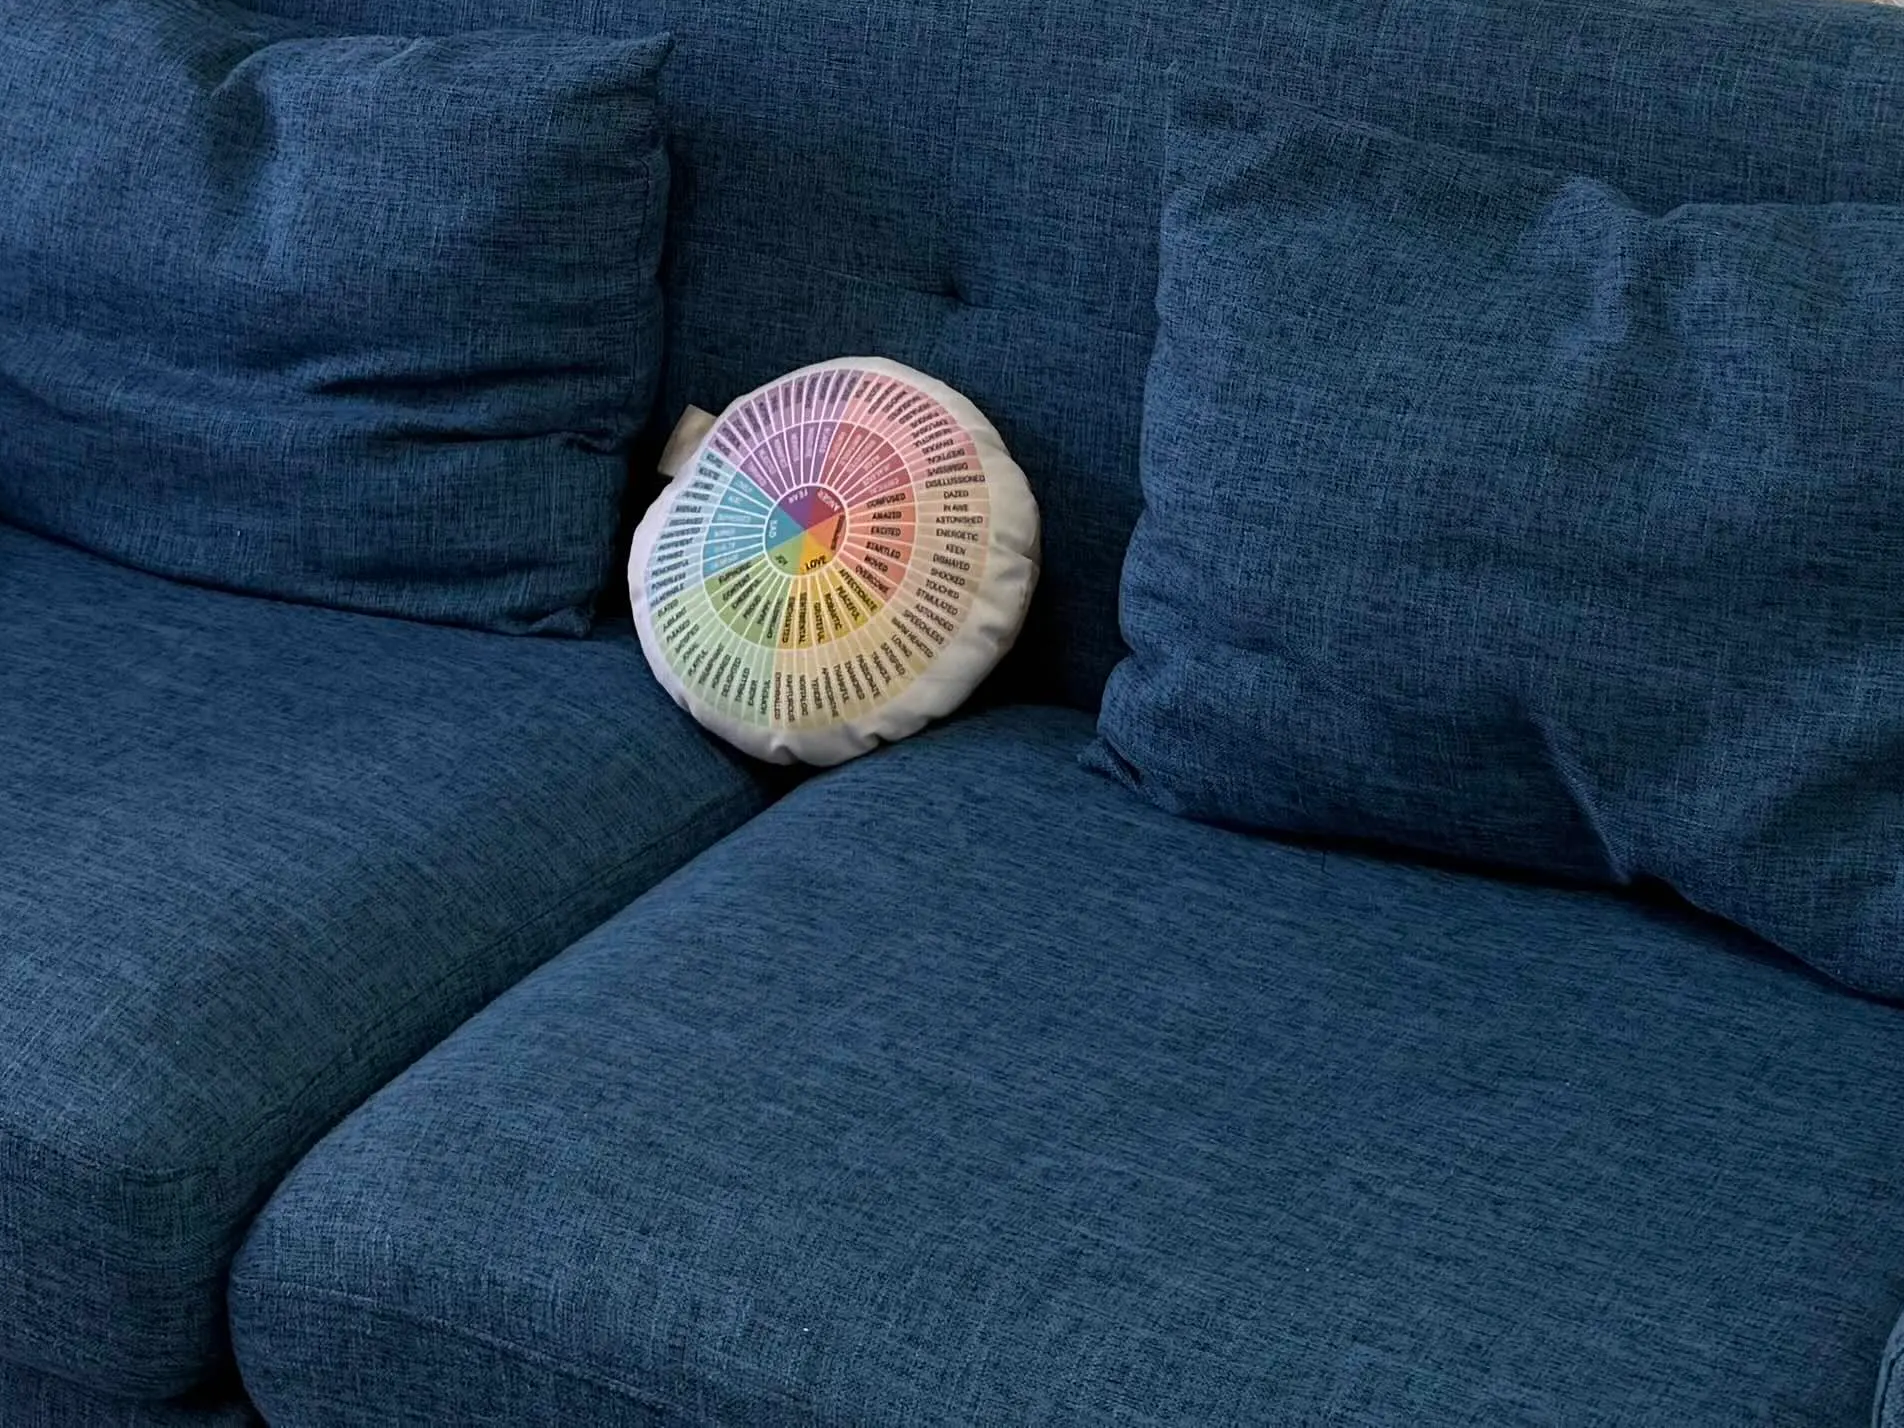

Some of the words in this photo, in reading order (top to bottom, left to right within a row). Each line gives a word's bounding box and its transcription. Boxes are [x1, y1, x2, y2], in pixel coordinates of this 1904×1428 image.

[788, 489, 808, 504] FEAR
[866, 493, 906, 508] CONFUSED
[943, 489, 969, 499] DAZED
[872, 511, 902, 519] AMAZED
[935, 515, 983, 524] ASTONISHED
[768, 520, 778, 538] SAD
[871, 526, 901, 537] EXCITED
[936, 528, 979, 542] ENERGETIC
[866, 541, 901, 558] STARTLED
[932, 553, 970, 571] DISMAYED
[946, 543, 966, 556] KEEN
[804, 554, 829, 572] LOVE
[864, 555, 888, 572] MOVED
[855, 565, 889, 594] OVERCOME
[925, 579, 960, 599] TOUCHED
[930, 567, 966, 586] SHOCKED
[836, 586, 860, 621] PEACEFUL
[840, 569, 878, 613] AFFECTIONATE
[916, 588, 959, 616] STIMULATED
[799, 592, 807, 644] SENTIMENTAL
[813, 602, 825, 643] GRATEFUL
[824, 593, 842, 630] ROMANTIC
[914, 603, 954, 632] ASTOUNDED
[666, 619, 691, 644] PLEASED
[721, 656, 741, 698] DELIGHTED
[734, 667, 750, 703] THRILLED
[832, 663, 851, 704] THANKFUL
[748, 679, 758, 706] EAGER
[786, 674, 795, 722] RAPTUROUS
[799, 674, 809, 717] NOSTALGIC
[811, 677, 823, 710] TENDER
